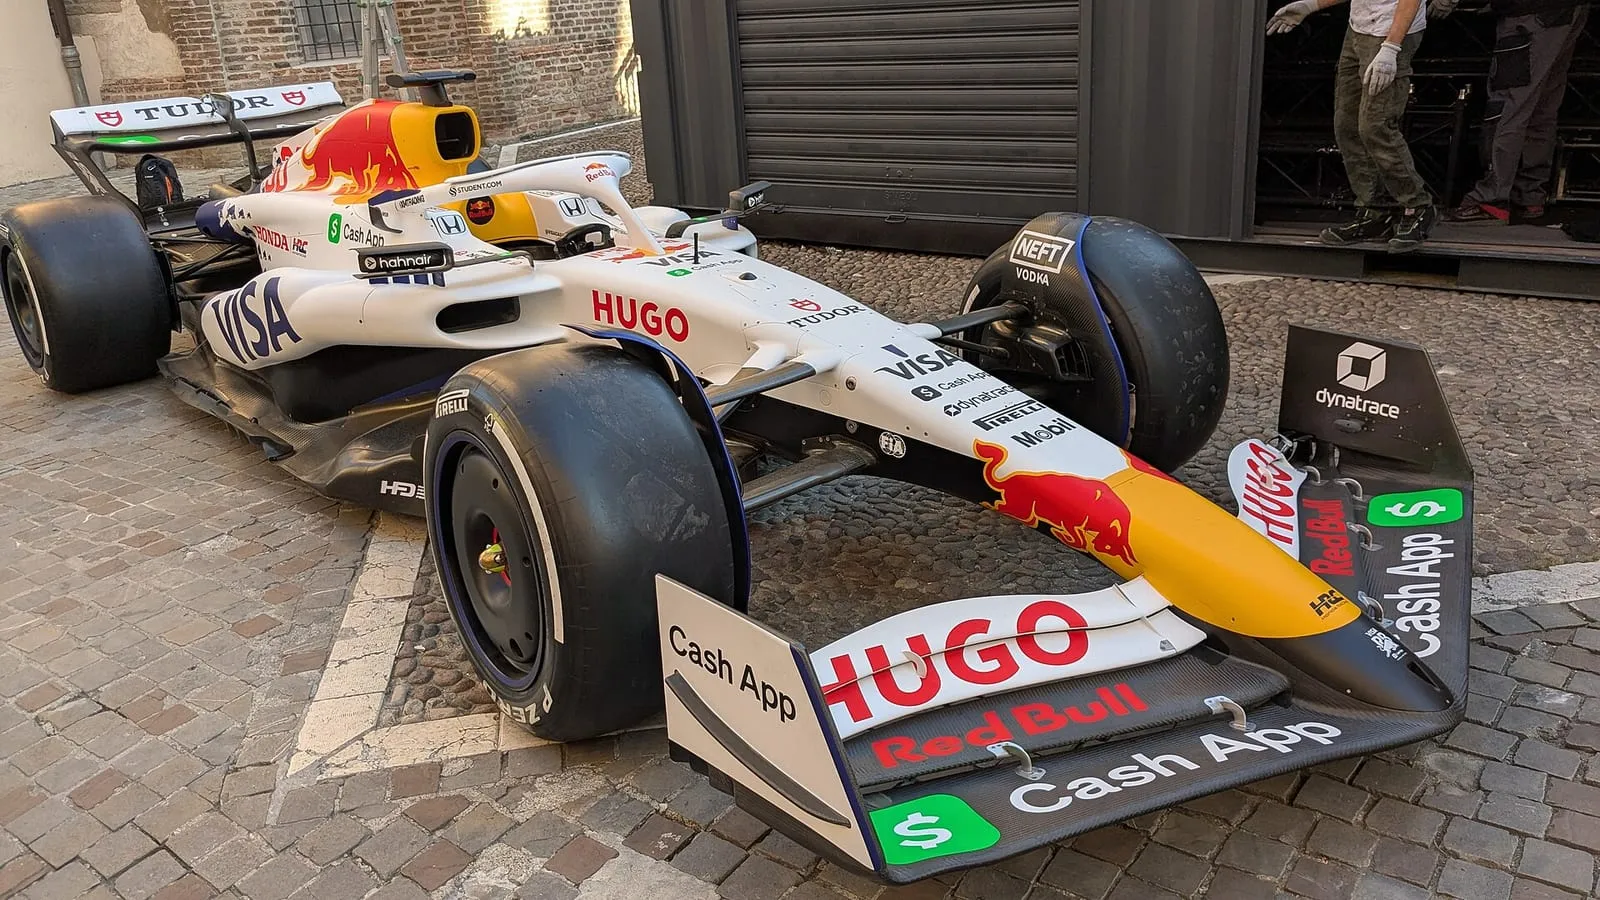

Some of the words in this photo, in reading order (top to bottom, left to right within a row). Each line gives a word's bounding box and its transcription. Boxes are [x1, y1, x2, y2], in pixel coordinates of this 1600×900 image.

[457, 181, 502, 194] STUDENT.COM
[252, 225, 290, 251] HONDA
[343, 223, 364, 244] Cash
[365, 229, 385, 247] App
[1016, 237, 1063, 263] NEFT
[379, 254, 432, 269] hahnair
[637, 250, 723, 266] VISA
[1015, 267, 1050, 287] VODKA
[211, 276, 303, 364] VISA
[592, 289, 690, 343] HUGO
[786, 304, 867, 328] TUDOR
[873, 349, 966, 380] VISA
[938, 376, 970, 391] Cash
[436, 389, 470, 418] PIRELLI
[972, 399, 1047, 431] PIRELLI
[1315, 388, 1400, 419] dynatrace
[1010, 417, 1077, 448] Mobil
[1242, 442, 1295, 545] HUGO
[1302, 499, 1348, 533] Bull
[1310, 531, 1355, 577] Red
[1386, 532, 1455, 578] App
[1384, 582, 1441, 658] Cash
[669, 625, 734, 685] Cash
[739, 664, 797, 723] App
[821, 600, 1088, 723] HUGO
[871, 710, 1014, 769] Red
[1010, 682, 1149, 737] Bull
[1009, 752, 1201, 814] Cash
[1199, 721, 1342, 763] App
